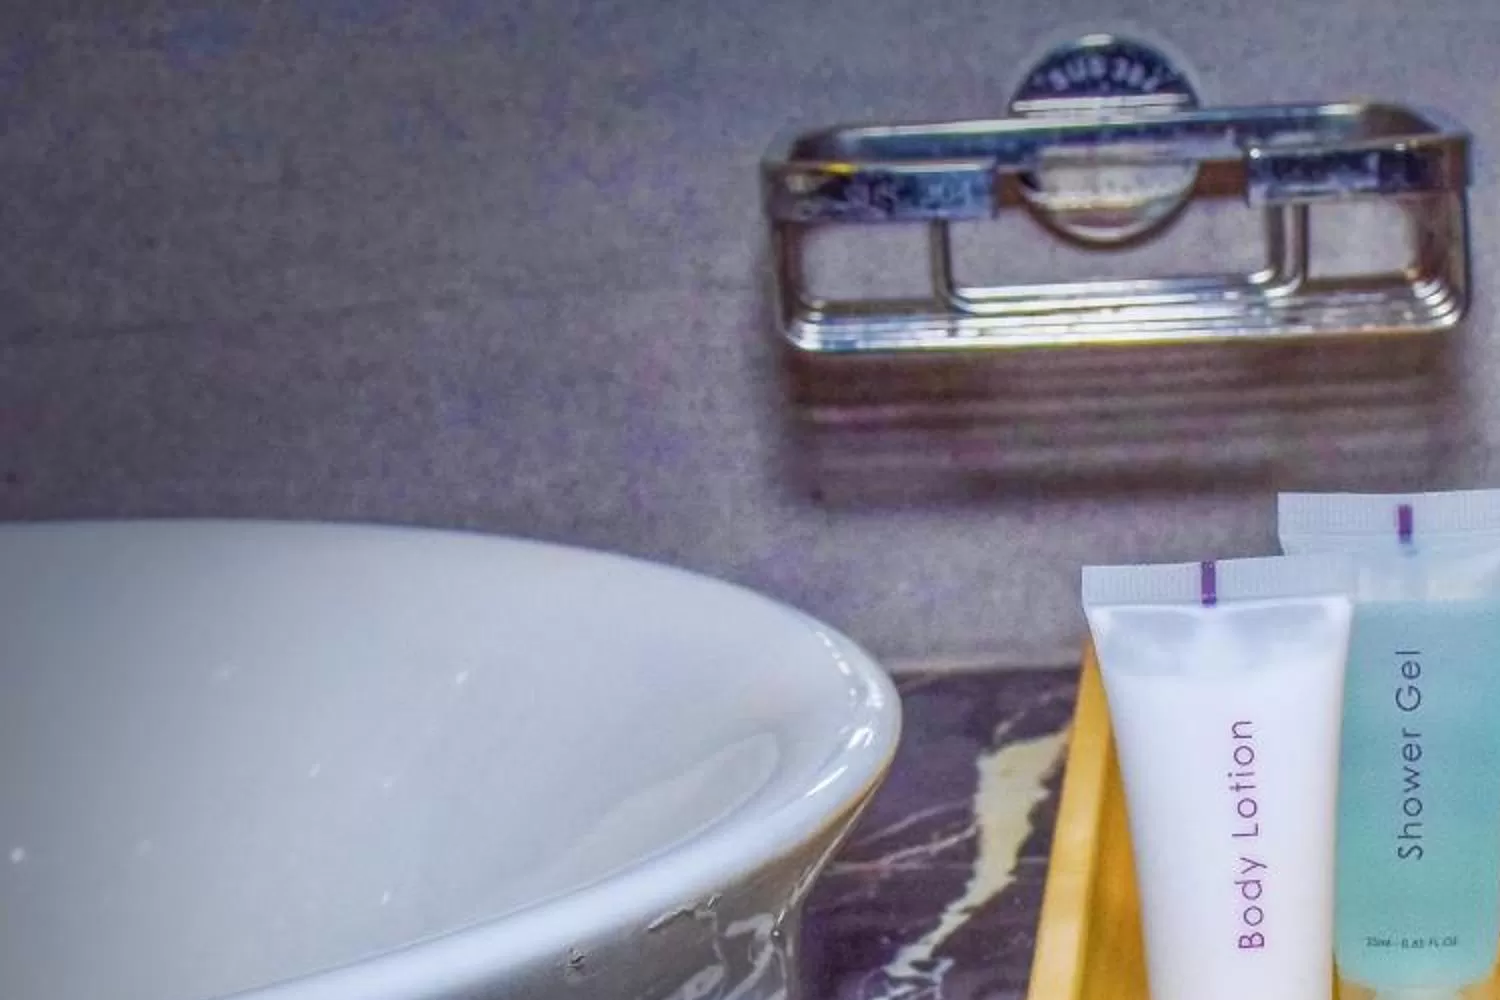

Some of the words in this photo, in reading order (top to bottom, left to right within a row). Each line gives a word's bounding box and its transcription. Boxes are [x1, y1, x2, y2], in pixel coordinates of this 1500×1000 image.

[1395, 650, 1422, 712] Gel
[1227, 719, 1259, 837] Lotion
[1397, 727, 1424, 860] Shower
[1234, 857, 1268, 949] Body
